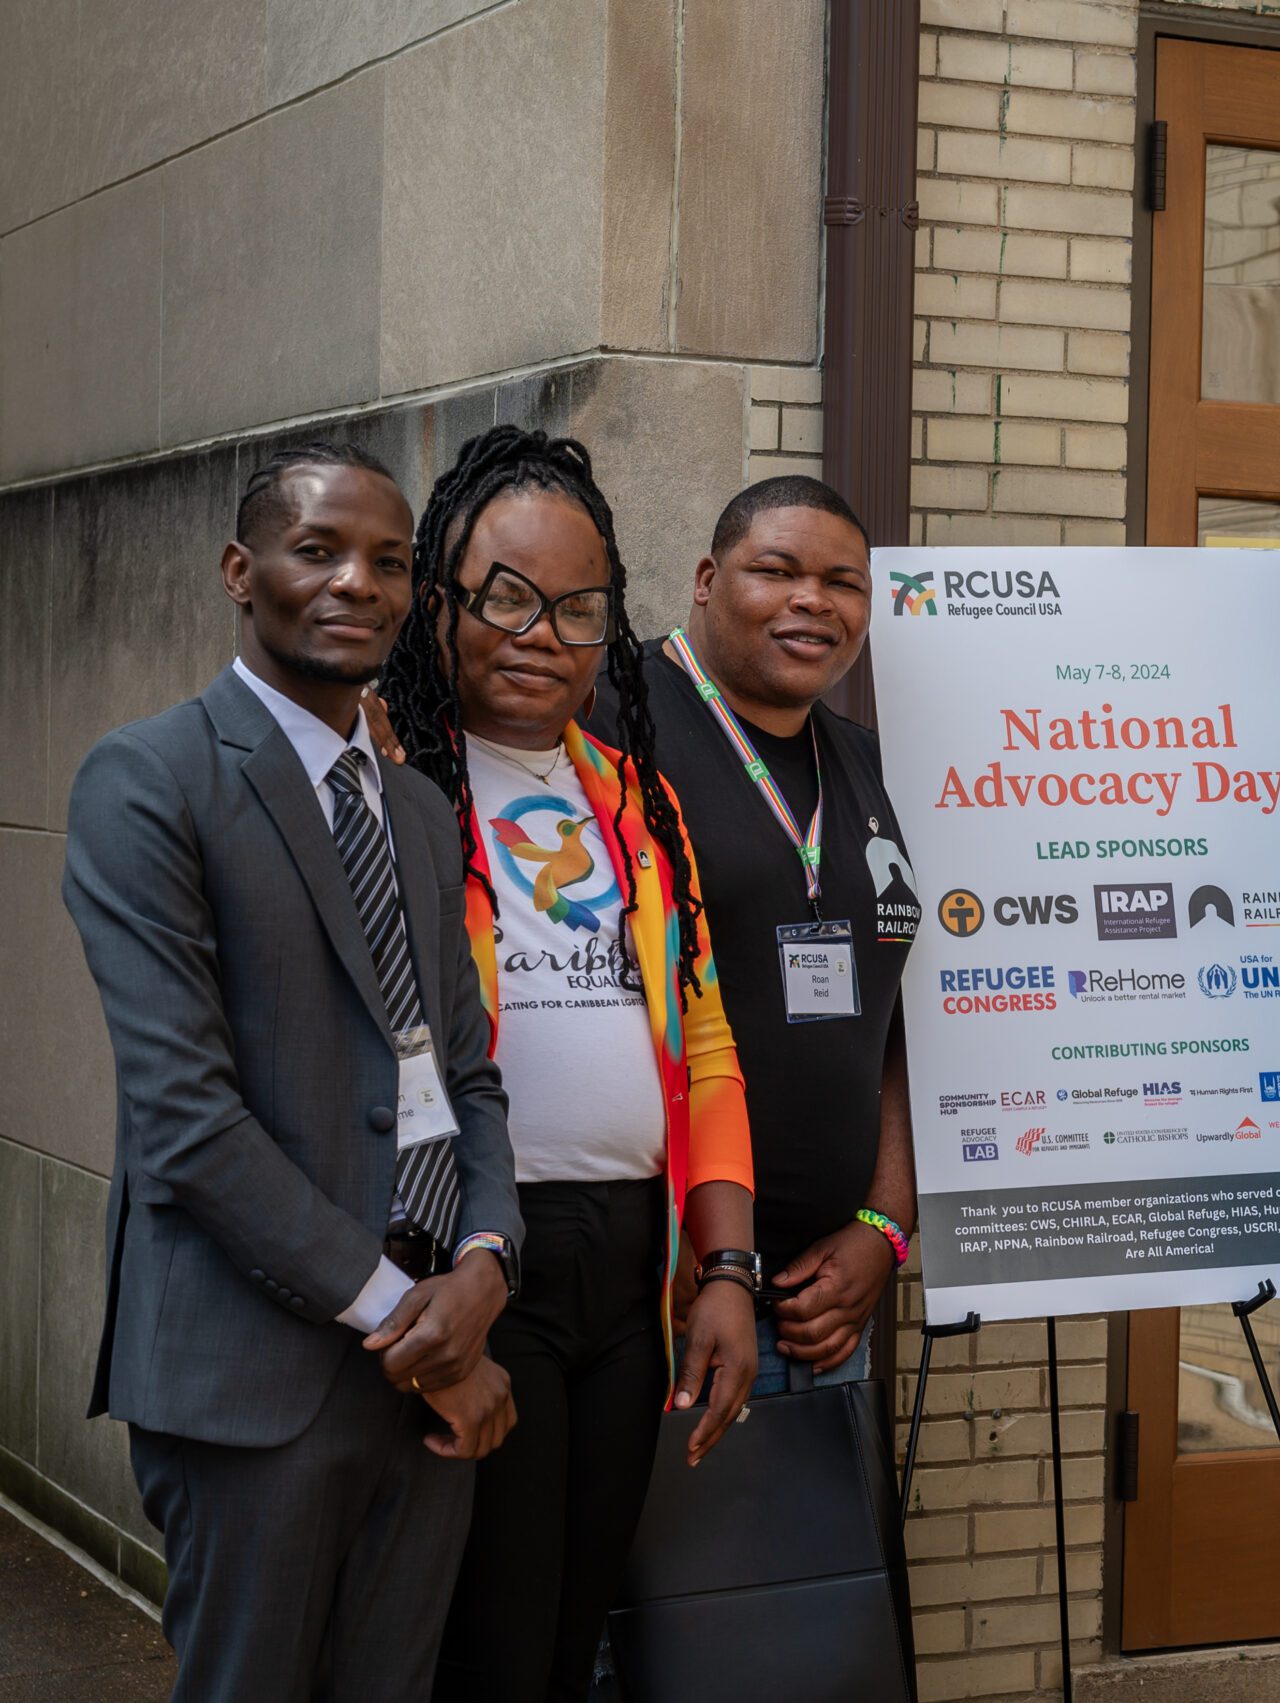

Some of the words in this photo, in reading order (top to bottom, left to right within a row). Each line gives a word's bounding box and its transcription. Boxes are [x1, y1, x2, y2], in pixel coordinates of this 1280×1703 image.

[943, 570, 1061, 598] RCUSA
[947, 603, 993, 619] Refugee
[995, 603, 1036, 616] Council
[1038, 602, 1062, 616] USA
[1056, 664, 1091, 684] May
[1095, 664, 1126, 682] 7-8,
[1130, 664, 1171, 680] 2024
[1000, 703, 1238, 751] National
[934, 761, 1182, 817] Advocacy
[1036, 841, 1090, 860] LEAD
[1095, 838, 1209, 858] SPONSORS
[1100, 890, 1169, 913] IRAP
[993, 894, 1079, 926] CWS
[1103, 917, 1144, 926] International
[1145, 917, 1171, 925] Refugee
[1139, 926, 1161, 935] Project
[801, 954, 829, 963] RCUSA
[1240, 955, 1259, 964] USA
[1260, 955, 1273, 963] for
[812, 974, 829, 983] Roan
[940, 965, 1055, 992] REFUGEE
[1089, 968, 1185, 992] ReHome
[814, 988, 829, 997] Reid
[1081, 994, 1106, 1003] Unlock
[1114, 993, 1136, 1001] better
[1138, 992, 1160, 1000] rental
[1161, 991, 1186, 999] market
[1244, 990, 1259, 999] The
[1260, 990, 1274, 998] UN
[542, 1000, 563, 1009] FOR
[564, 999, 619, 1009] CARIBBEAN
[943, 992, 1057, 1015] CONGRESS
[1051, 1040, 1168, 1061] CONTRIBUTING
[1171, 1038, 1250, 1055] SPONSORS
[1071, 1088, 1103, 1099] Global
[1104, 1087, 1138, 1100] Refuge
[1142, 1081, 1182, 1096] HIAS
[1219, 1087, 1239, 1095] Rights
[1239, 1086, 1253, 1094] First
[939, 1093, 989, 1102] COMMUNITY
[939, 1099, 997, 1109] SPONSORSHIP
[1000, 1090, 1046, 1107] ECAR
[940, 1108, 958, 1116] HUB
[960, 1127, 997, 1136] REFUGEE
[1041, 1135, 1053, 1144] U.S.
[1055, 1133, 1089, 1144] COMMITTEE
[1117, 1134, 1156, 1144] CATHOLIC
[1157, 1132, 1189, 1142] BISHOPS
[1196, 1131, 1234, 1143] Upwardly
[1235, 1130, 1261, 1140] Global
[965, 1145, 996, 1160] LAB
[961, 1204, 997, 1218] Thank
[1001, 1205, 1024, 1218] you
[1026, 1203, 1039, 1214] to
[1041, 1200, 1082, 1213] RCUSA
[1084, 1197, 1132, 1210] member
[1133, 1191, 1209, 1209] organizations
[1210, 1189, 1234, 1201] who
[1236, 1186, 1273, 1200] served
[954, 1222, 1028, 1236] committees:
[1030, 1218, 1060, 1231] CWS,
[1062, 1215, 1110, 1229] CHIRLA,
[1111, 1213, 1146, 1226] ECAR,
[1148, 1210, 1185, 1223] Global
[1187, 1208, 1229, 1222] Refuge,
[1231, 1205, 1262, 1218] HIAS,
[960, 1240, 992, 1254] IRAP,
[994, 1237, 1032, 1251] NPNA,
[1034, 1235, 1084, 1248] Rainbow
[1086, 1230, 1138, 1244] Railroad,
[1140, 1228, 1186, 1242] Refugee
[1187, 1225, 1242, 1239] Congress,
[1244, 1221, 1280, 1234] USCRI,
[1125, 1248, 1145, 1259] Are
[1147, 1245, 1163, 1257] All
[1165, 1242, 1215, 1256] America!
